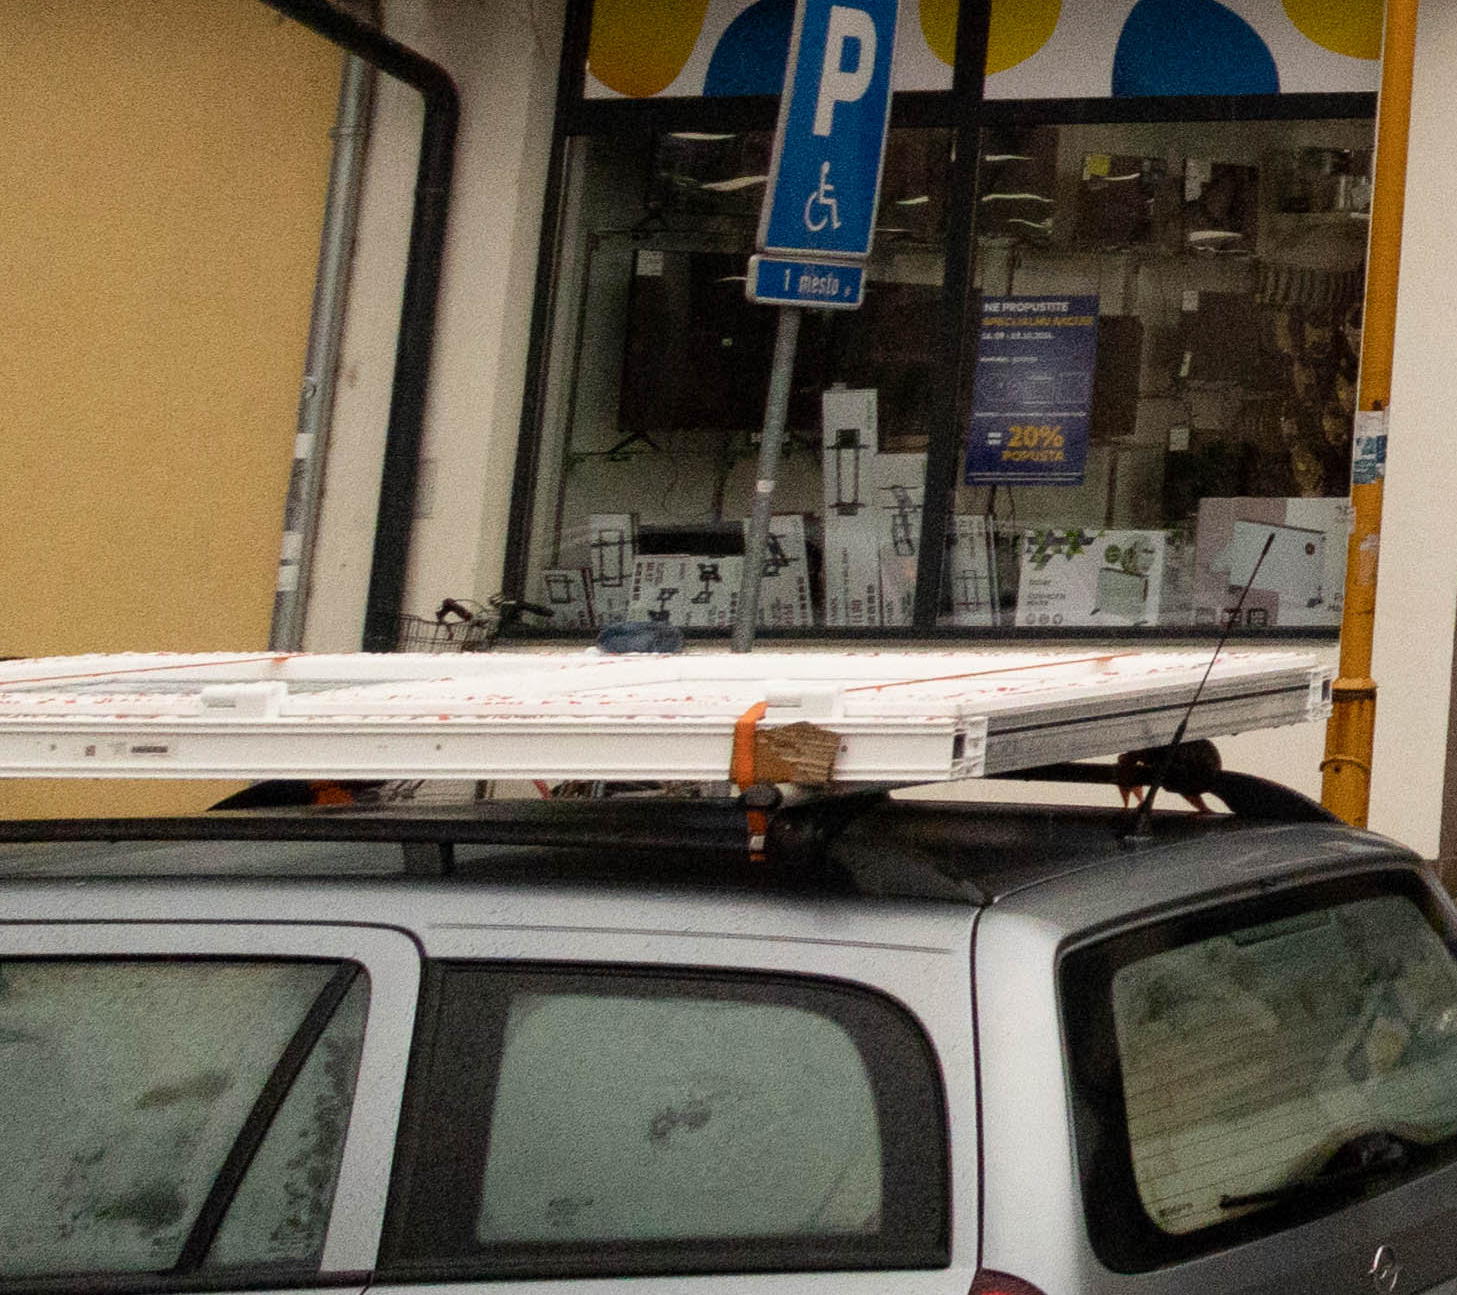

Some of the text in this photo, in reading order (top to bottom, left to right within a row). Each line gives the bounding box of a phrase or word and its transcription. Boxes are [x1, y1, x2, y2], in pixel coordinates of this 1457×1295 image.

[812, 5, 877, 137] P
[784, 269, 791, 291] 1
[1008, 425, 1064, 448] 20%
